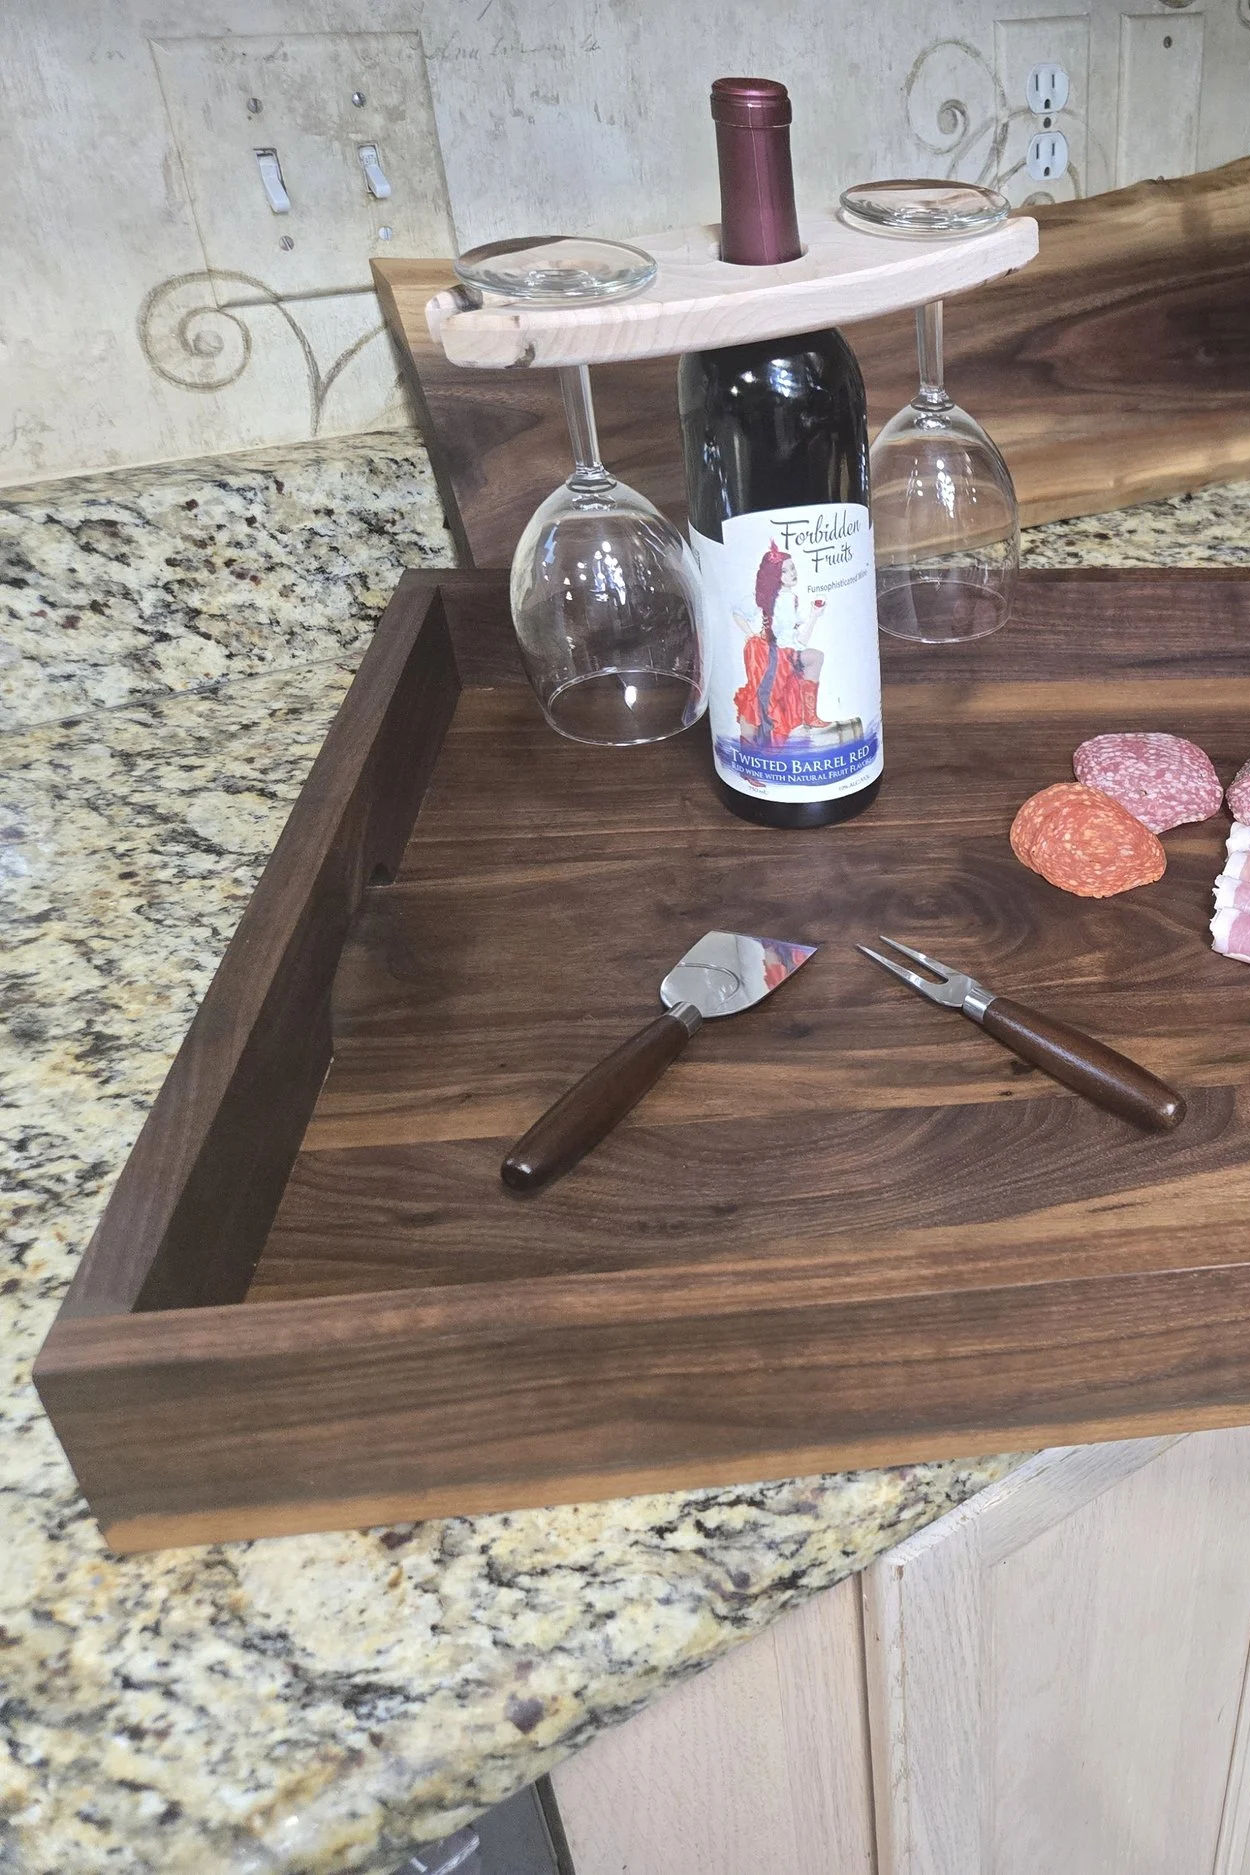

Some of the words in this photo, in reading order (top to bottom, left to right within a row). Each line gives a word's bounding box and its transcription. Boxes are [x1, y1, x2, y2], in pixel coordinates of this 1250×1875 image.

[769, 509, 861, 550] Forbidden
[802, 542, 853, 573] Fruits
[807, 575, 858, 593] Funsophisticated
[731, 748, 787, 772] TWISTED
[791, 755, 847, 774] BARREL
[849, 745, 870, 763] RED
[745, 768, 763, 779] WINE
[764, 773, 786, 782] WITH
[787, 773, 828, 783] NATURAL
[828, 768, 849, 780] FRUIT
